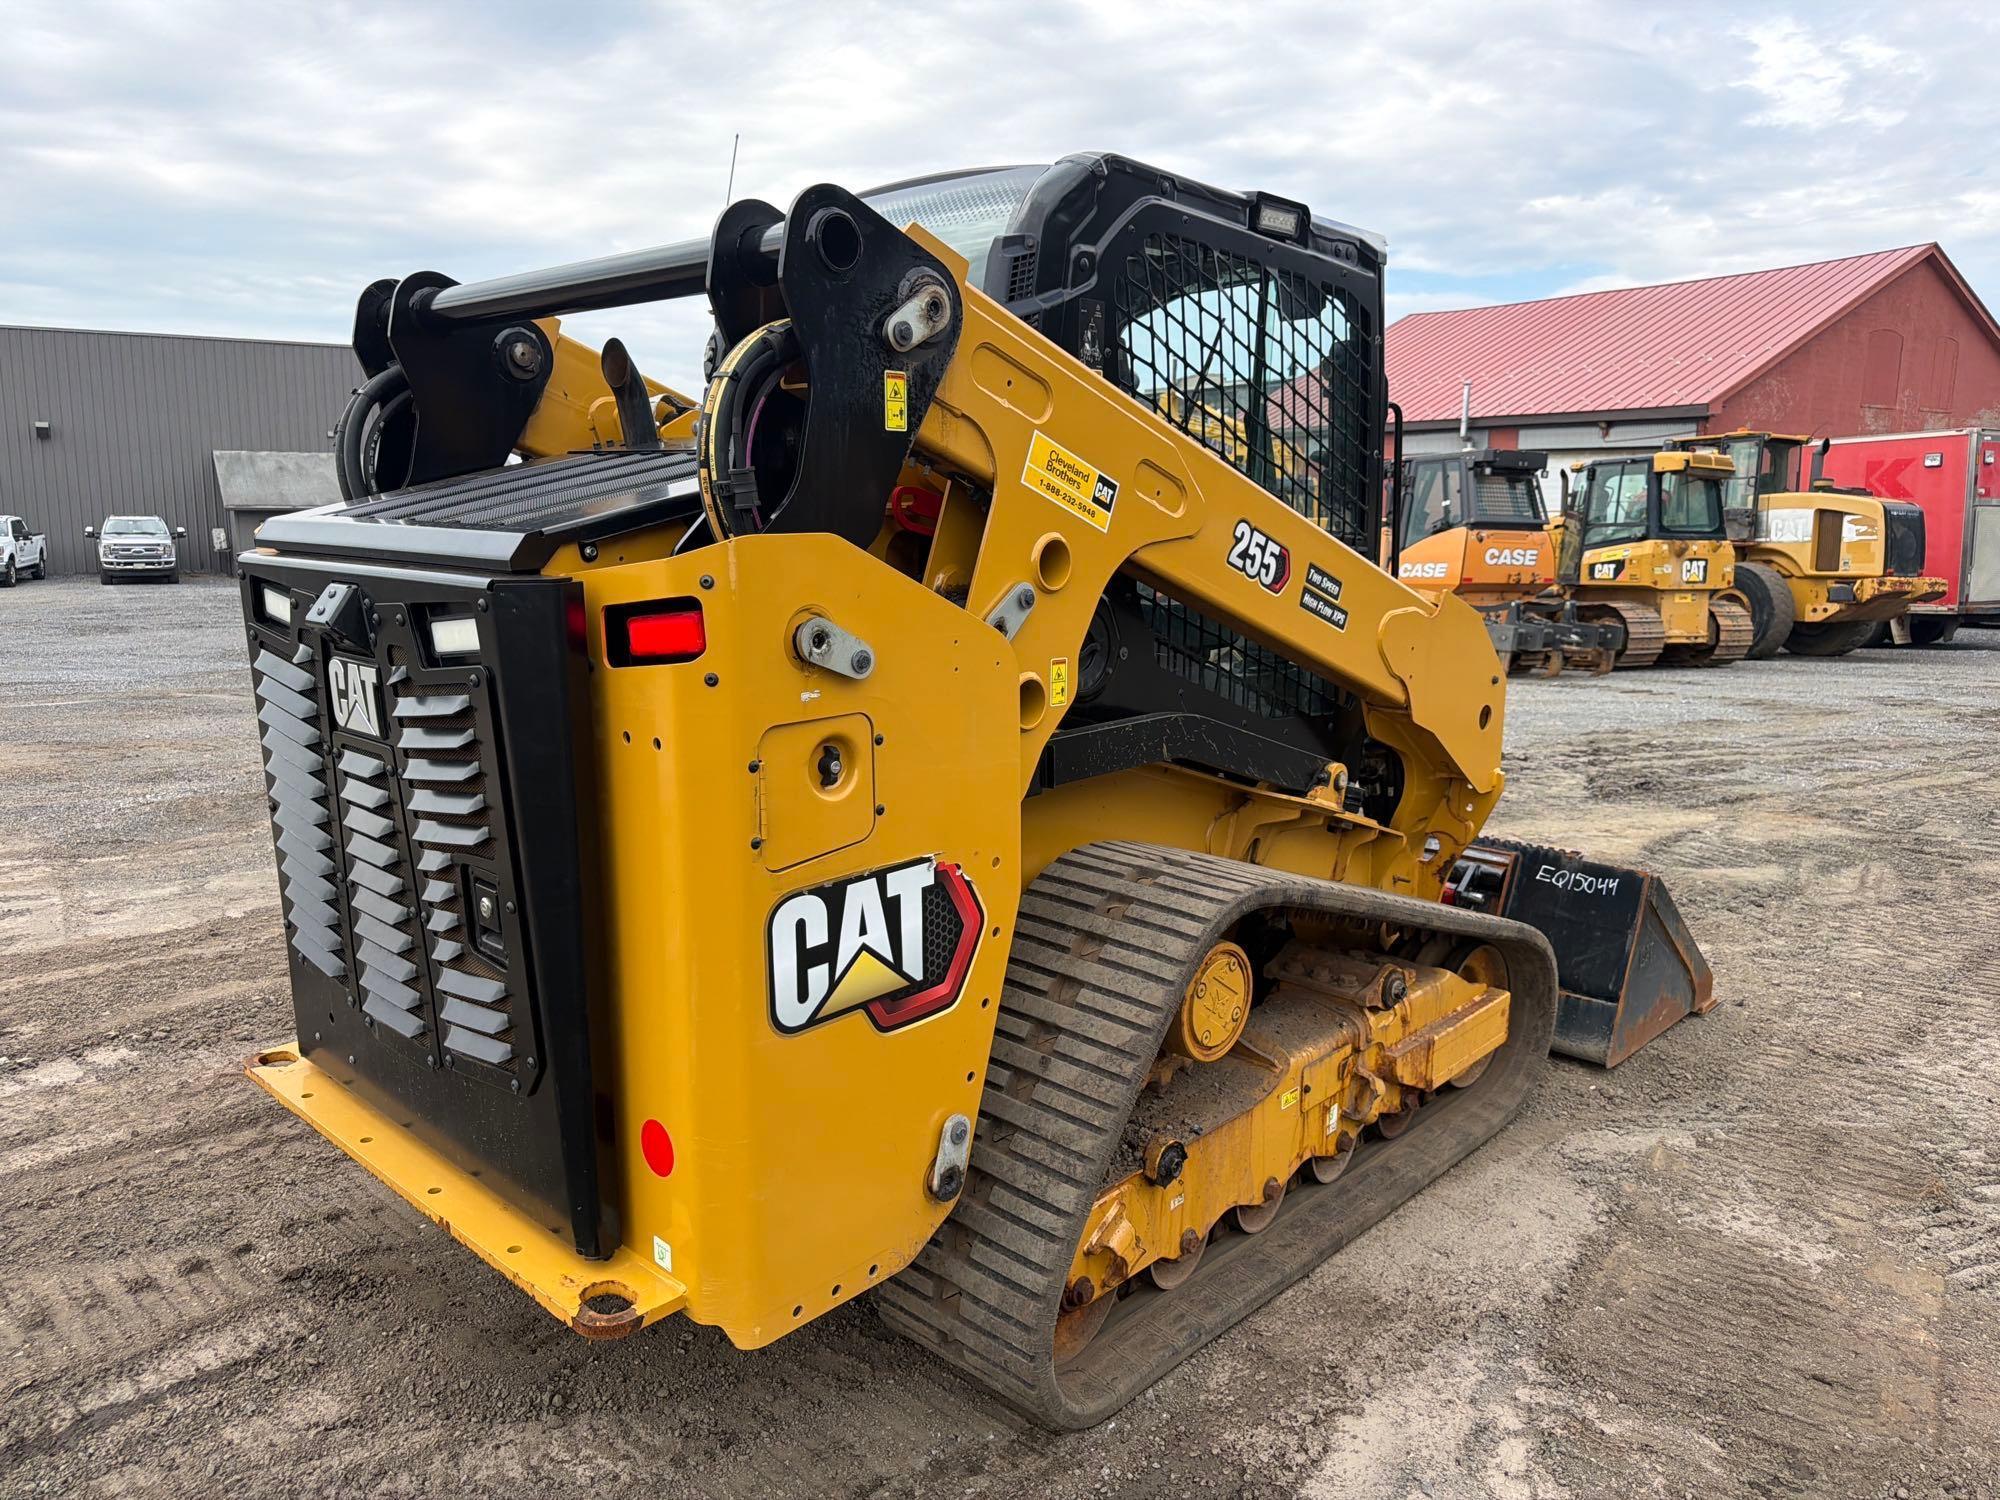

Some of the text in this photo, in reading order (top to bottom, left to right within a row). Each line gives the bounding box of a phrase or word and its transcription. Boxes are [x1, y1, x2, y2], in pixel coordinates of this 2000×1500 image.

[1046, 459, 1082, 490] Brothers
[1049, 449, 1090, 483] Cleveland
[1039, 478, 1096, 518] 1-888-232-5948
[1094, 482, 1114, 505] CAT
[1771, 519, 1808, 542] CAT
[1228, 521, 1281, 585] 255
[1485, 548, 1539, 566] CASE
[1398, 562, 1448, 578] CASE
[1595, 563, 1616, 579] CAT
[1682, 560, 1706, 581] CAT
[1332, 609, 1346, 625] XPS
[328, 658, 381, 737] CAT
[1535, 864, 1620, 896] EQ15044
[771, 861, 935, 1028] CAT
